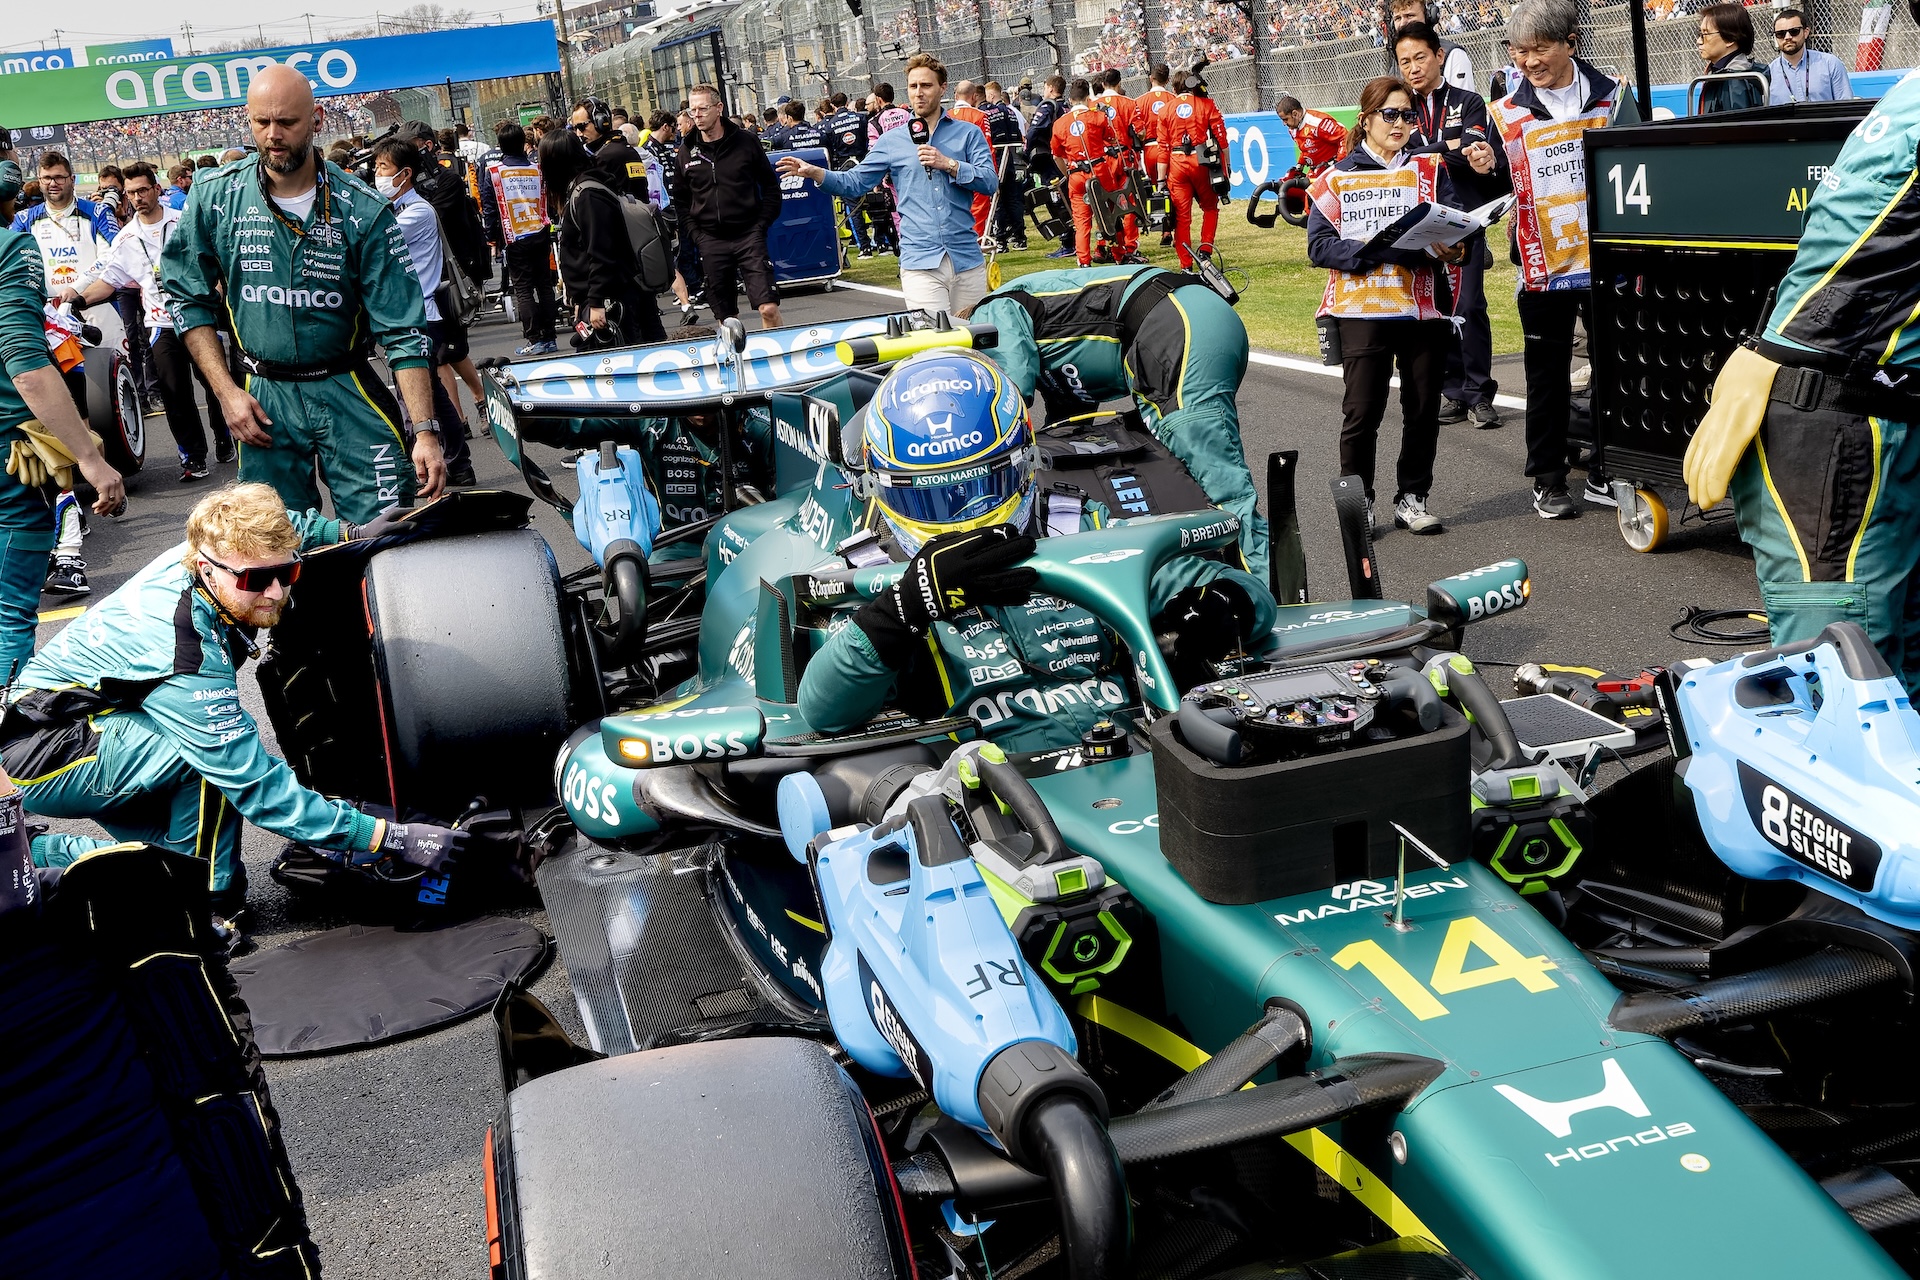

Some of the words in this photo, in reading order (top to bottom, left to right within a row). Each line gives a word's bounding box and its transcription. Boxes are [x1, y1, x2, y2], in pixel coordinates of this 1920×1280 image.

[0, 55, 64, 74] mco
[834, 123, 860, 134] KOMATSU
[792, 140, 820, 148] KOMATSU
[1546, 145, 1584, 158] 0068-
[1343, 188, 1401, 203] 0069-JPN
[1420, 171, 1432, 203] JAP
[1608, 164, 1651, 216] 14
[233, 215, 273, 224] MAADEN
[1342, 205, 1411, 223] CRUTINEER
[1366, 219, 1379, 231] F1
[234, 228, 275, 238] cognizant
[308, 226, 342, 240] araco
[50, 246, 78, 258] VISA
[240, 244, 270, 254] BOSS
[311, 250, 343, 260] Honda
[241, 261, 272, 271] JCB
[301, 268, 341, 281] CoreWeave
[314, 260, 341, 271] Valvoline
[51, 277, 65, 286] Red
[241, 282, 344, 309] aramco
[525, 320, 893, 401] aramco
[900, 379, 973, 402] aramco
[776, 417, 797, 451] ASTON
[907, 430, 983, 457] aramco
[930, 432, 954, 440] Honda
[370, 443, 400, 515] ARTIN
[667, 469, 696, 479] BOSS
[915, 474, 950, 486] ASTON
[950, 465, 989, 481] MARTIN
[1110, 475, 1150, 515] LEF
[722, 523, 745, 548] Powered
[1191, 517, 1240, 542] BREITLING
[816, 578, 846, 599] Cognition
[916, 556, 939, 619] aramco
[946, 587, 967, 609] 14
[1467, 579, 1524, 622] BOSS
[1049, 616, 1096, 633] Honda
[1272, 604, 1411, 634] MAADEN
[962, 637, 1008, 661] BOSS
[1059, 634, 1099, 649] Valvoline
[971, 661, 1022, 684] JCB
[967, 679, 1124, 728] aramco
[650, 730, 749, 763] BOSS
[563, 760, 622, 827] BOSS
[1761, 784, 1790, 847] 8
[1789, 806, 1852, 858] EIGHT
[417, 838, 441, 852] HyFlex
[1790, 833, 1853, 881] SLEEP
[417, 873, 451, 905] RE
[1273, 876, 1469, 926] MAADEN
[966, 958, 1026, 1000] RF
[1330, 915, 1560, 1021] 14
[884, 1003, 919, 1071] EIGHT
[1544, 1118, 1697, 1168] Honda
